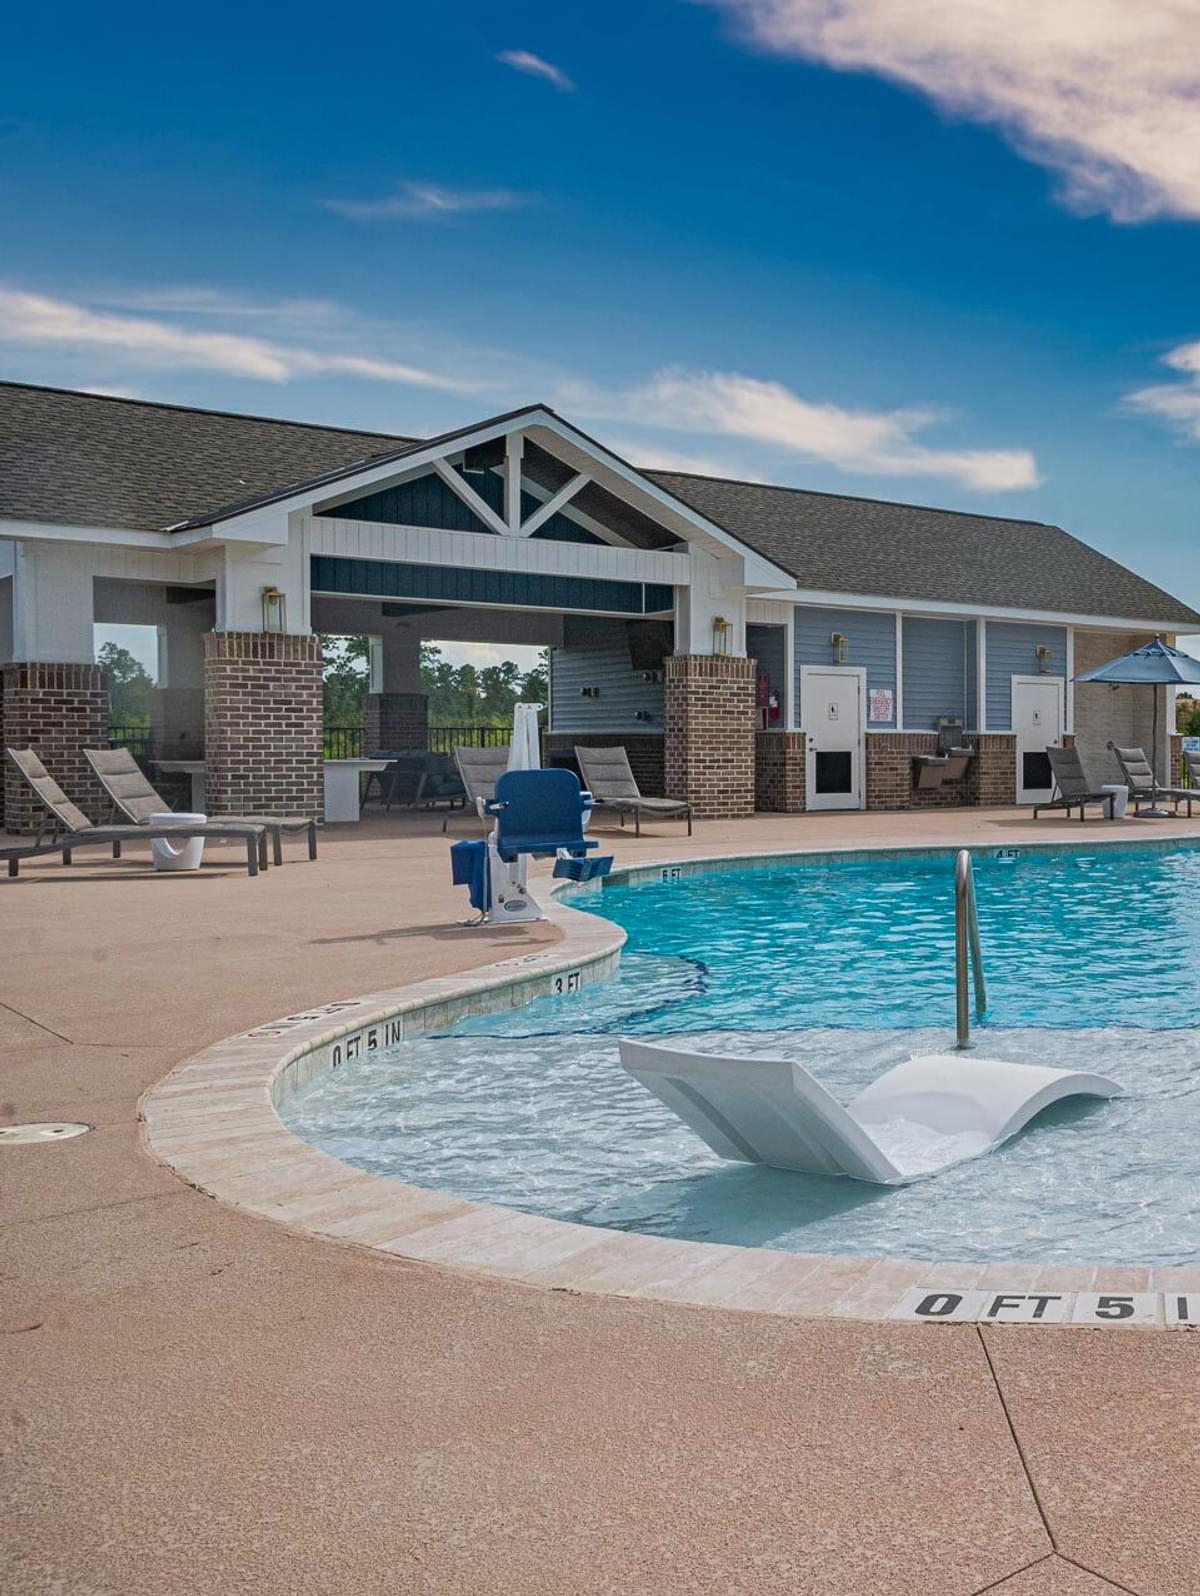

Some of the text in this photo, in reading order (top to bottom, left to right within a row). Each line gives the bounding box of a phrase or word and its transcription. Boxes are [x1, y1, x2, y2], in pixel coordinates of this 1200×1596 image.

[555, 972, 580, 993] 3 FT
[333, 1020, 400, 1068] 0 FT 5 IN
[914, 1293, 963, 1317] 0
[987, 1295, 1061, 1318] FT
[1095, 1297, 1135, 1319] 5
